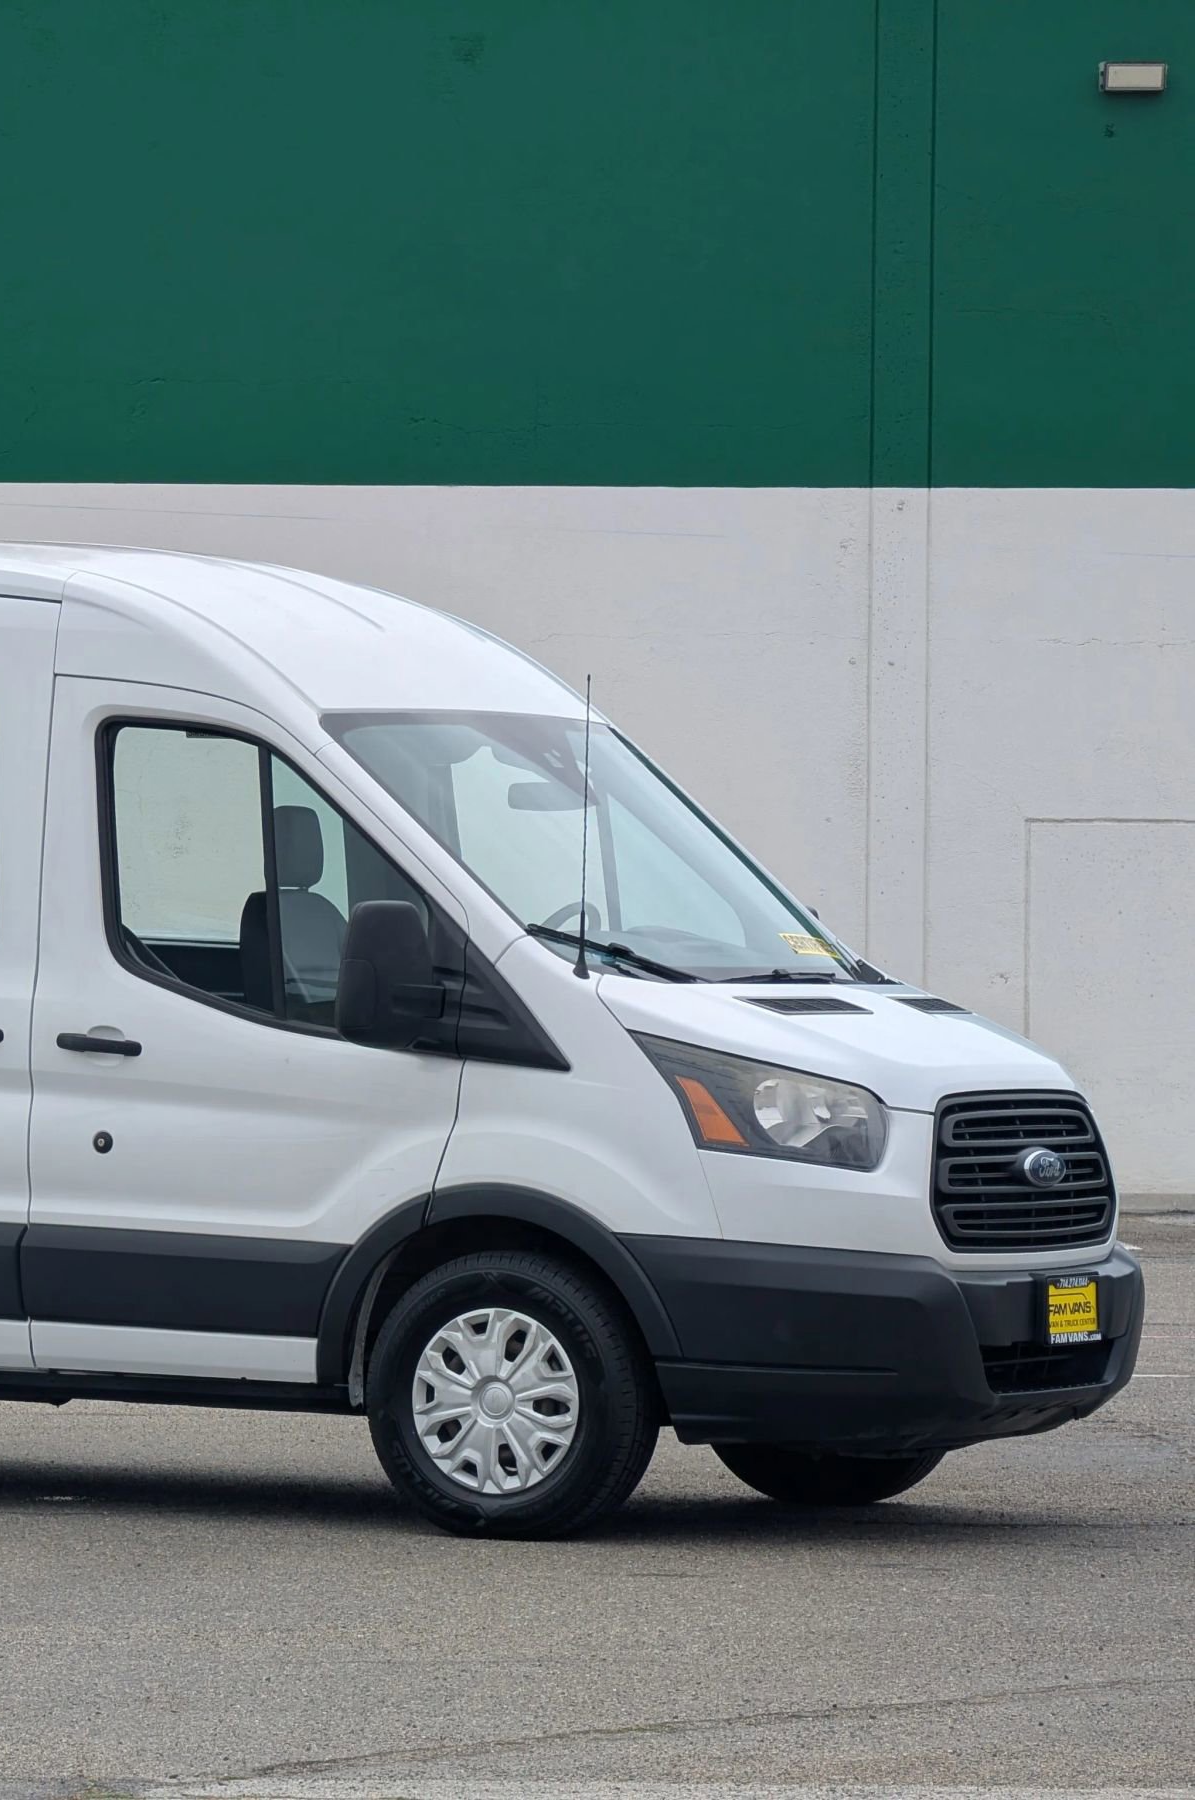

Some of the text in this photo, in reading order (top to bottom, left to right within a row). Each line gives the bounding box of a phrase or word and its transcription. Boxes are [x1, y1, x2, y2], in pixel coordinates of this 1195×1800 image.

[1039, 1156, 1060, 1177] Ford
[1048, 1301, 1092, 1316] FAM VANS
[1064, 1318, 1079, 1327] TRUCK
[1079, 1317, 1096, 1326] CENTER
